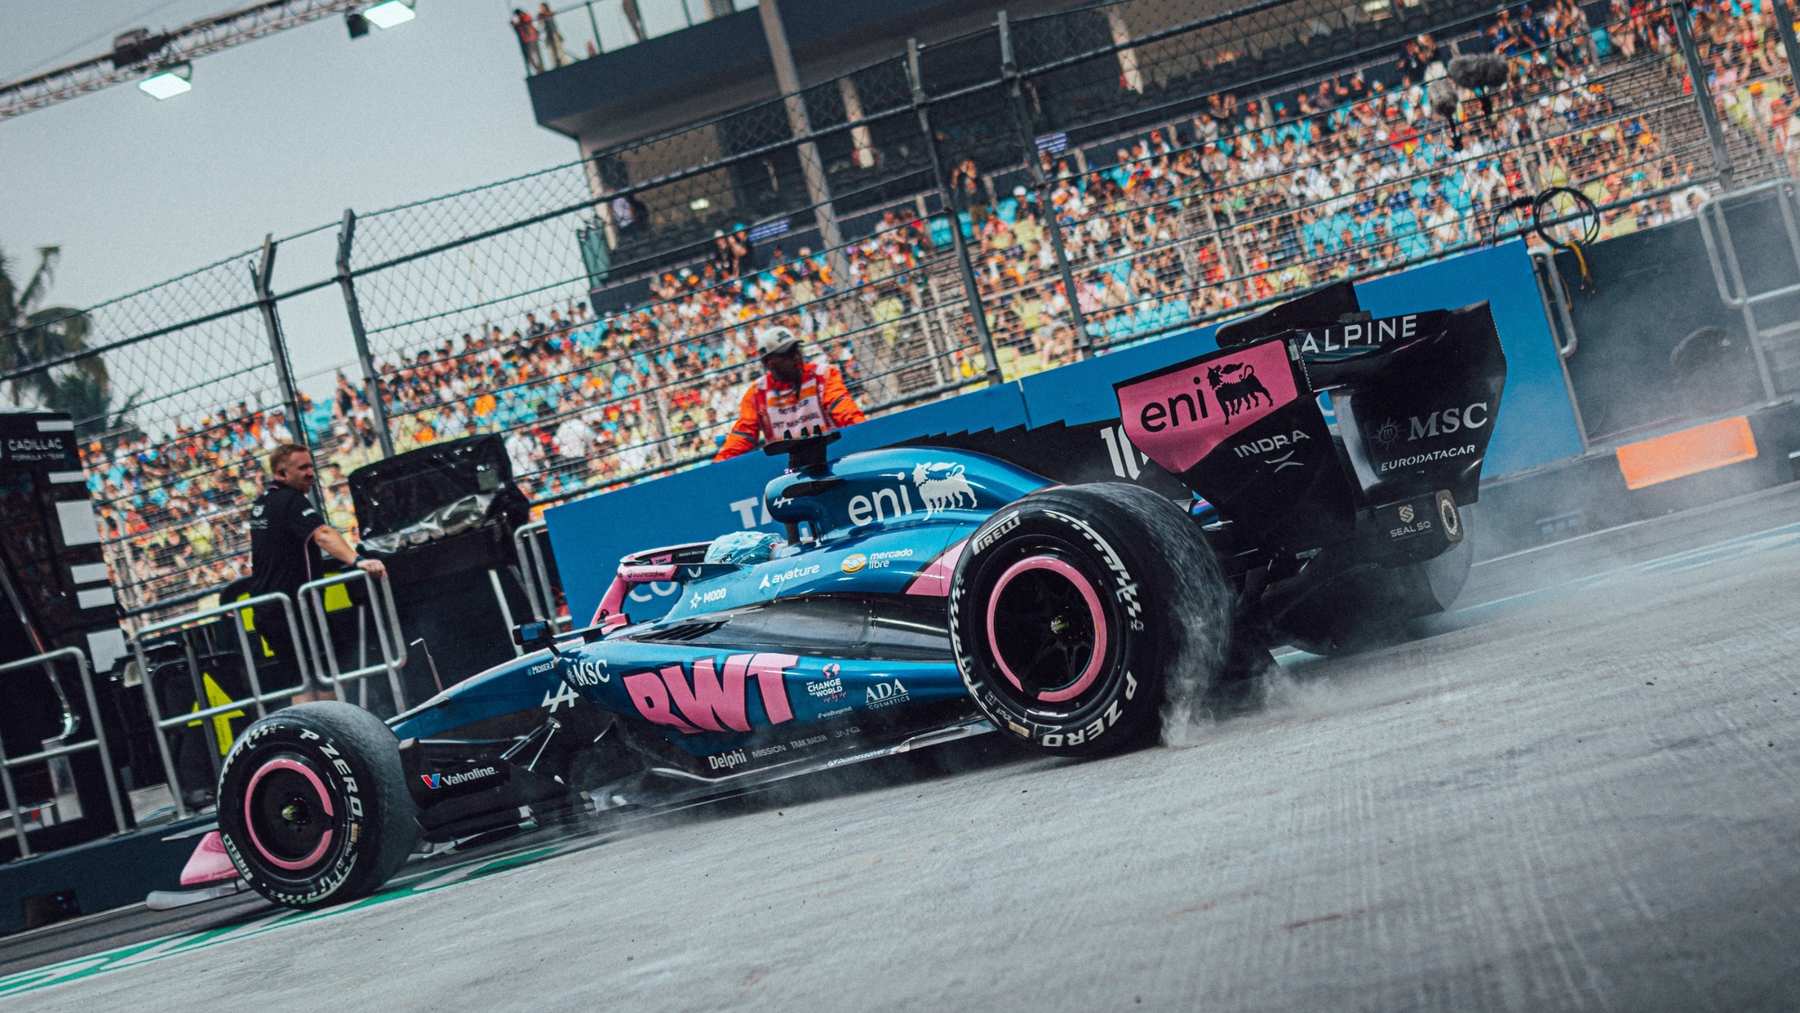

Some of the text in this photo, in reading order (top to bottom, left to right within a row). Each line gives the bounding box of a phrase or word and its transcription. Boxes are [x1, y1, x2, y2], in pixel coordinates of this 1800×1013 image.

[1301, 314, 1417, 353] ALPINE
[1140, 376, 1209, 432] eni
[1407, 402, 1488, 441] MSC
[8, 438, 63, 452] CADILLAC
[1233, 430, 1310, 458] INDRA
[1381, 444, 1475, 472] EURODATACAR
[848, 472, 913, 527] eni
[972, 510, 1021, 555] PIRELLI
[1390, 525, 1416, 538] SEAL
[869, 559, 890, 569] libre
[870, 548, 913, 560] mercado
[771, 563, 820, 583] avature
[572, 659, 610, 687] MSC
[807, 678, 842, 692] CHANGE
[1126, 671, 1138, 700] P
[816, 686, 843, 697] WORLD
[866, 679, 909, 703] ADA
[1042, 700, 1123, 747] ZERO
[708, 749, 748, 770] Delphi
[752, 744, 786, 759] MISSION
[299, 728, 364, 818] P ZERO
[442, 765, 496, 787] Valvoline
